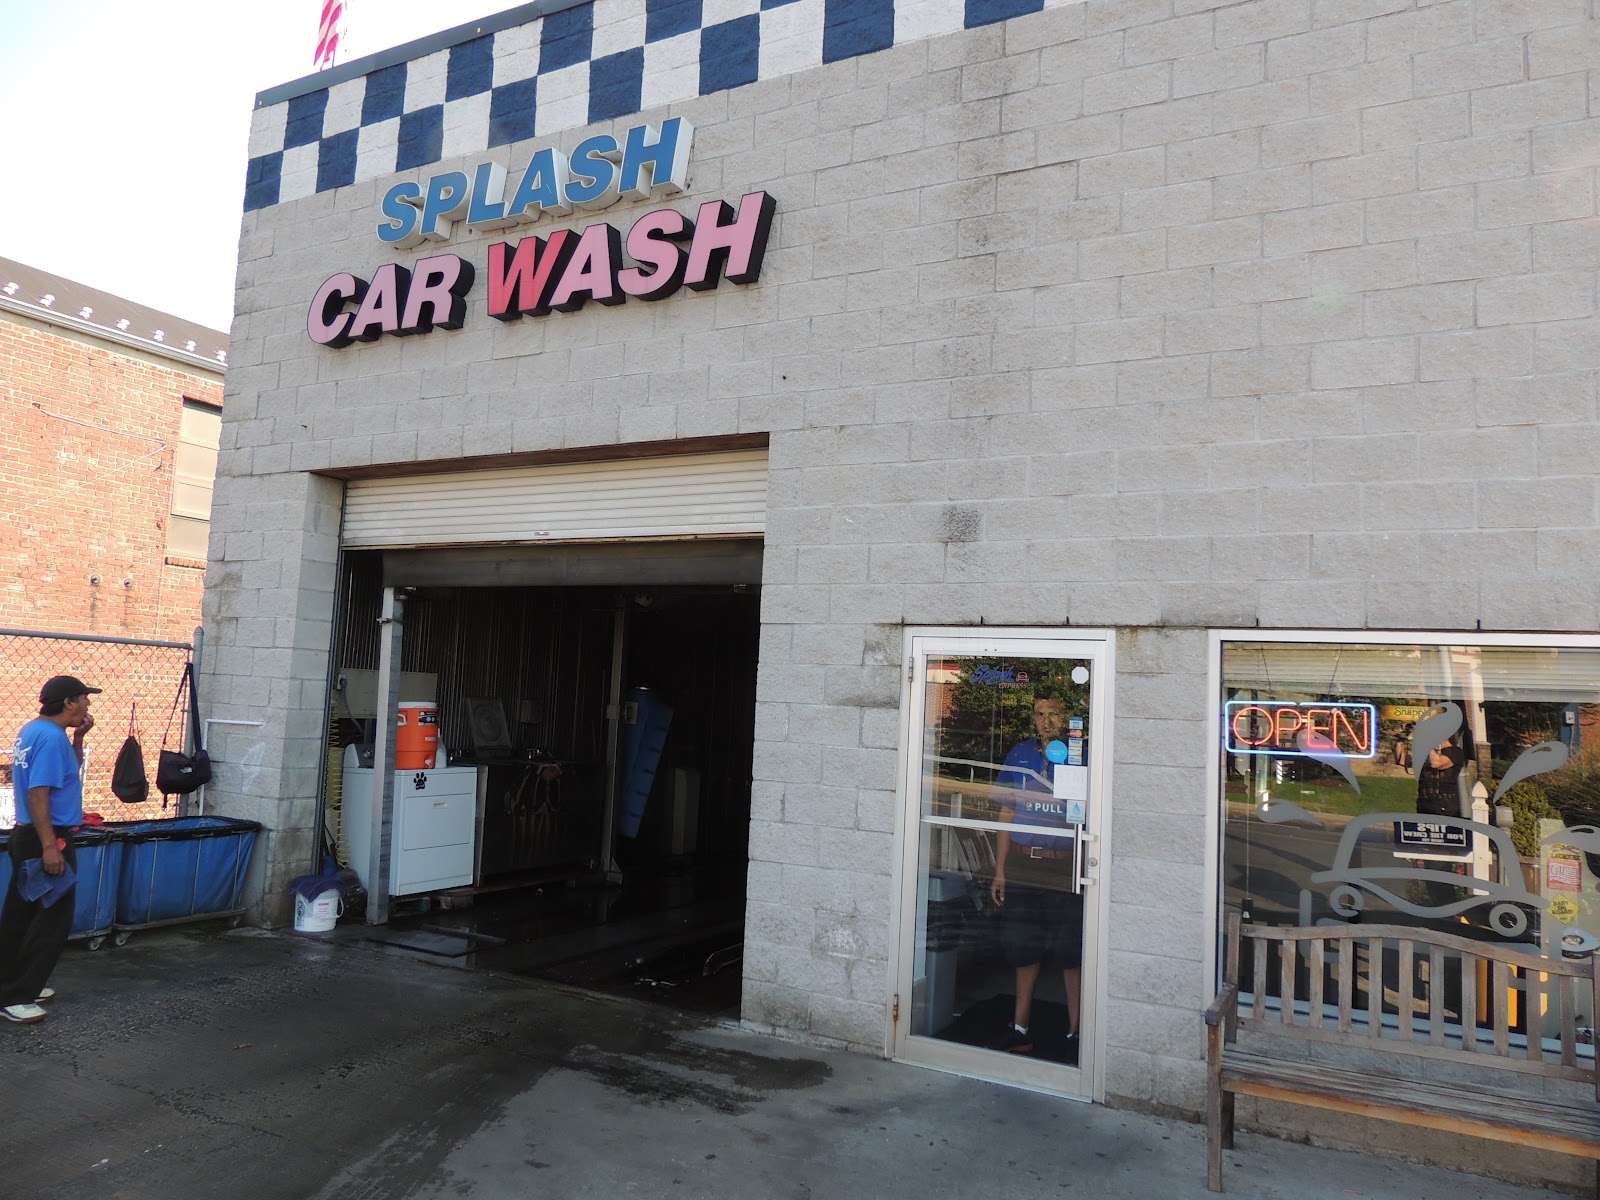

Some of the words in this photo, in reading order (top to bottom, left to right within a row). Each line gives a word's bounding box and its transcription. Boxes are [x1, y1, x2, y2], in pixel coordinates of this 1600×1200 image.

[376, 116, 689, 246] SPLASH
[307, 253, 468, 346] CAR
[487, 190, 772, 319] WASH
[969, 664, 1015, 686] Splash
[1232, 706, 1369, 750] OPEN
[1394, 706, 1430, 719] Snapp
[1034, 802, 1063, 814] PULL
